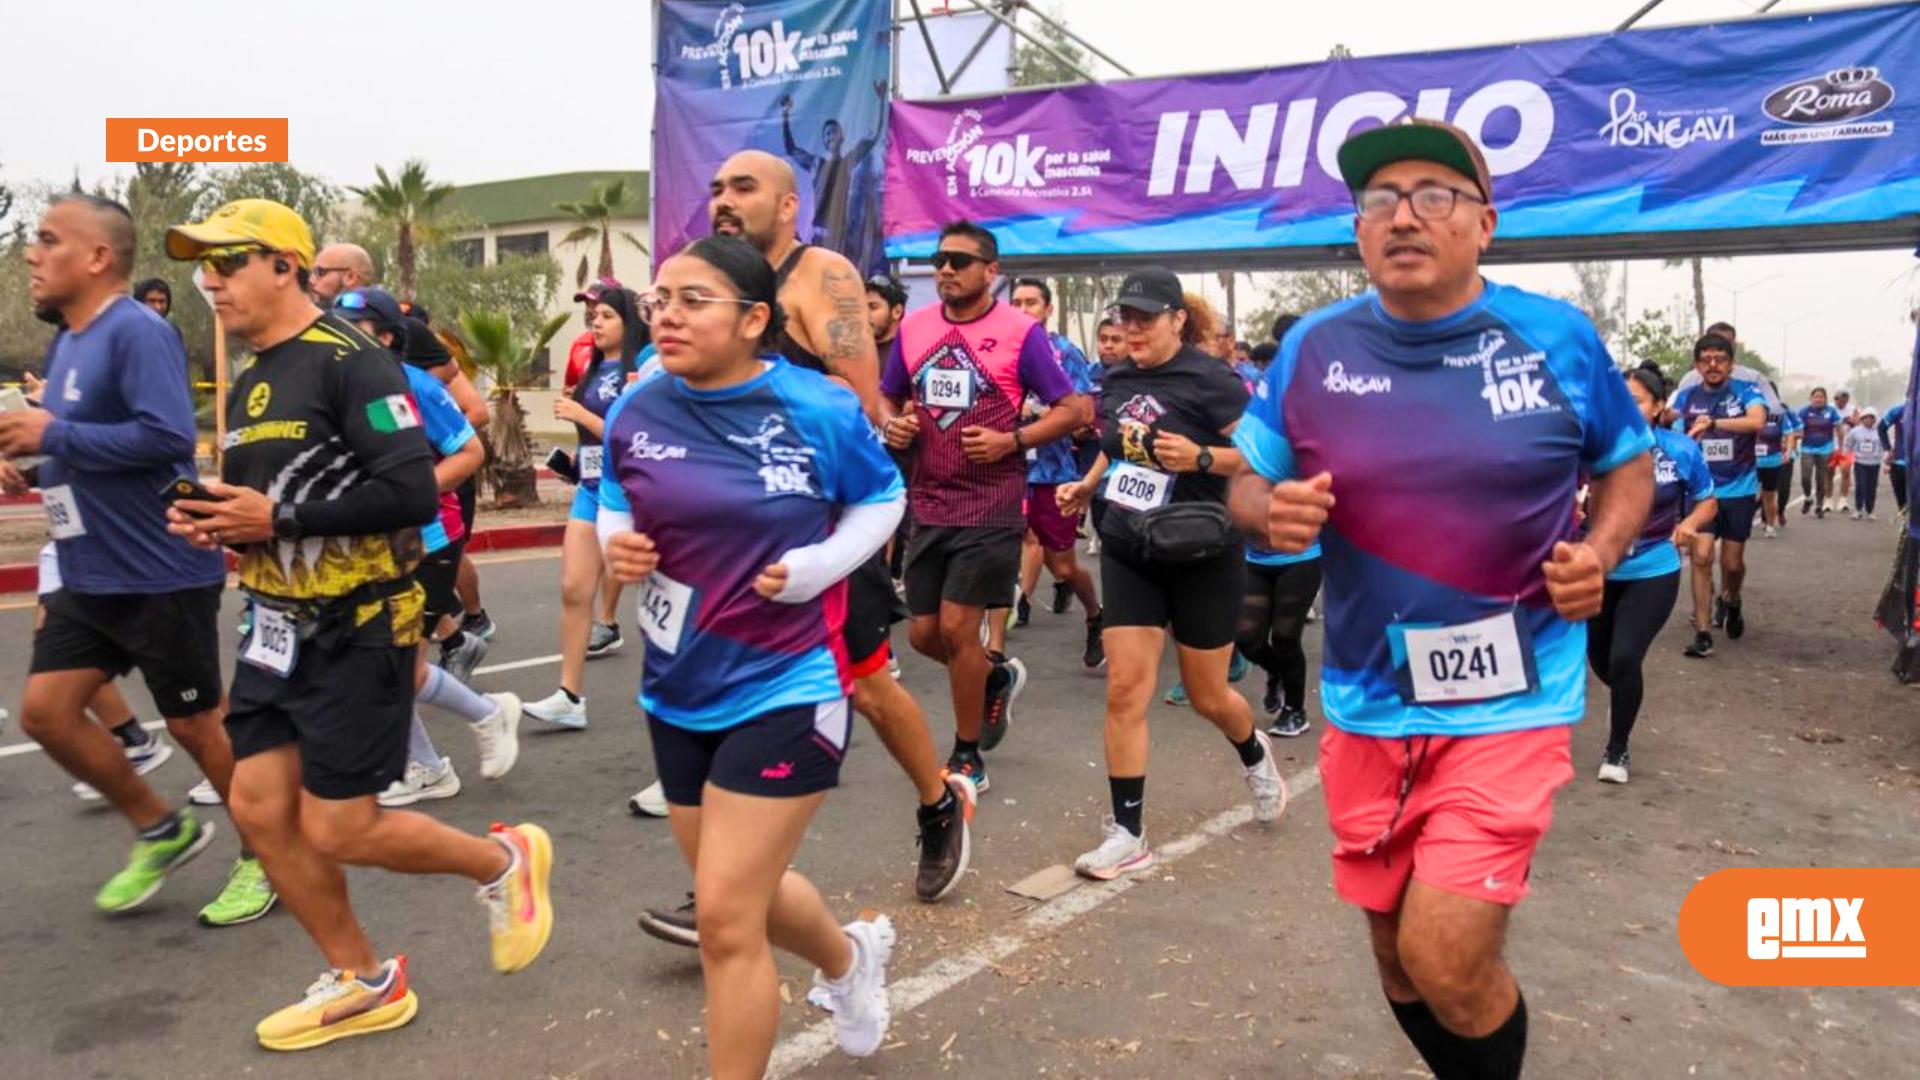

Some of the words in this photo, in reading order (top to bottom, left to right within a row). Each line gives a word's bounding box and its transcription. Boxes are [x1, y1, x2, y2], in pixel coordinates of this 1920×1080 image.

[1782, 85, 1872, 118] Roma
[963, 135, 1047, 187] 10k
[1082, 149, 1111, 163] salud
[931, 379, 962, 398] 0294
[1481, 372, 1550, 416] 10k
[1118, 475, 1156, 502] 0208
[1429, 643, 1499, 682] 0241
